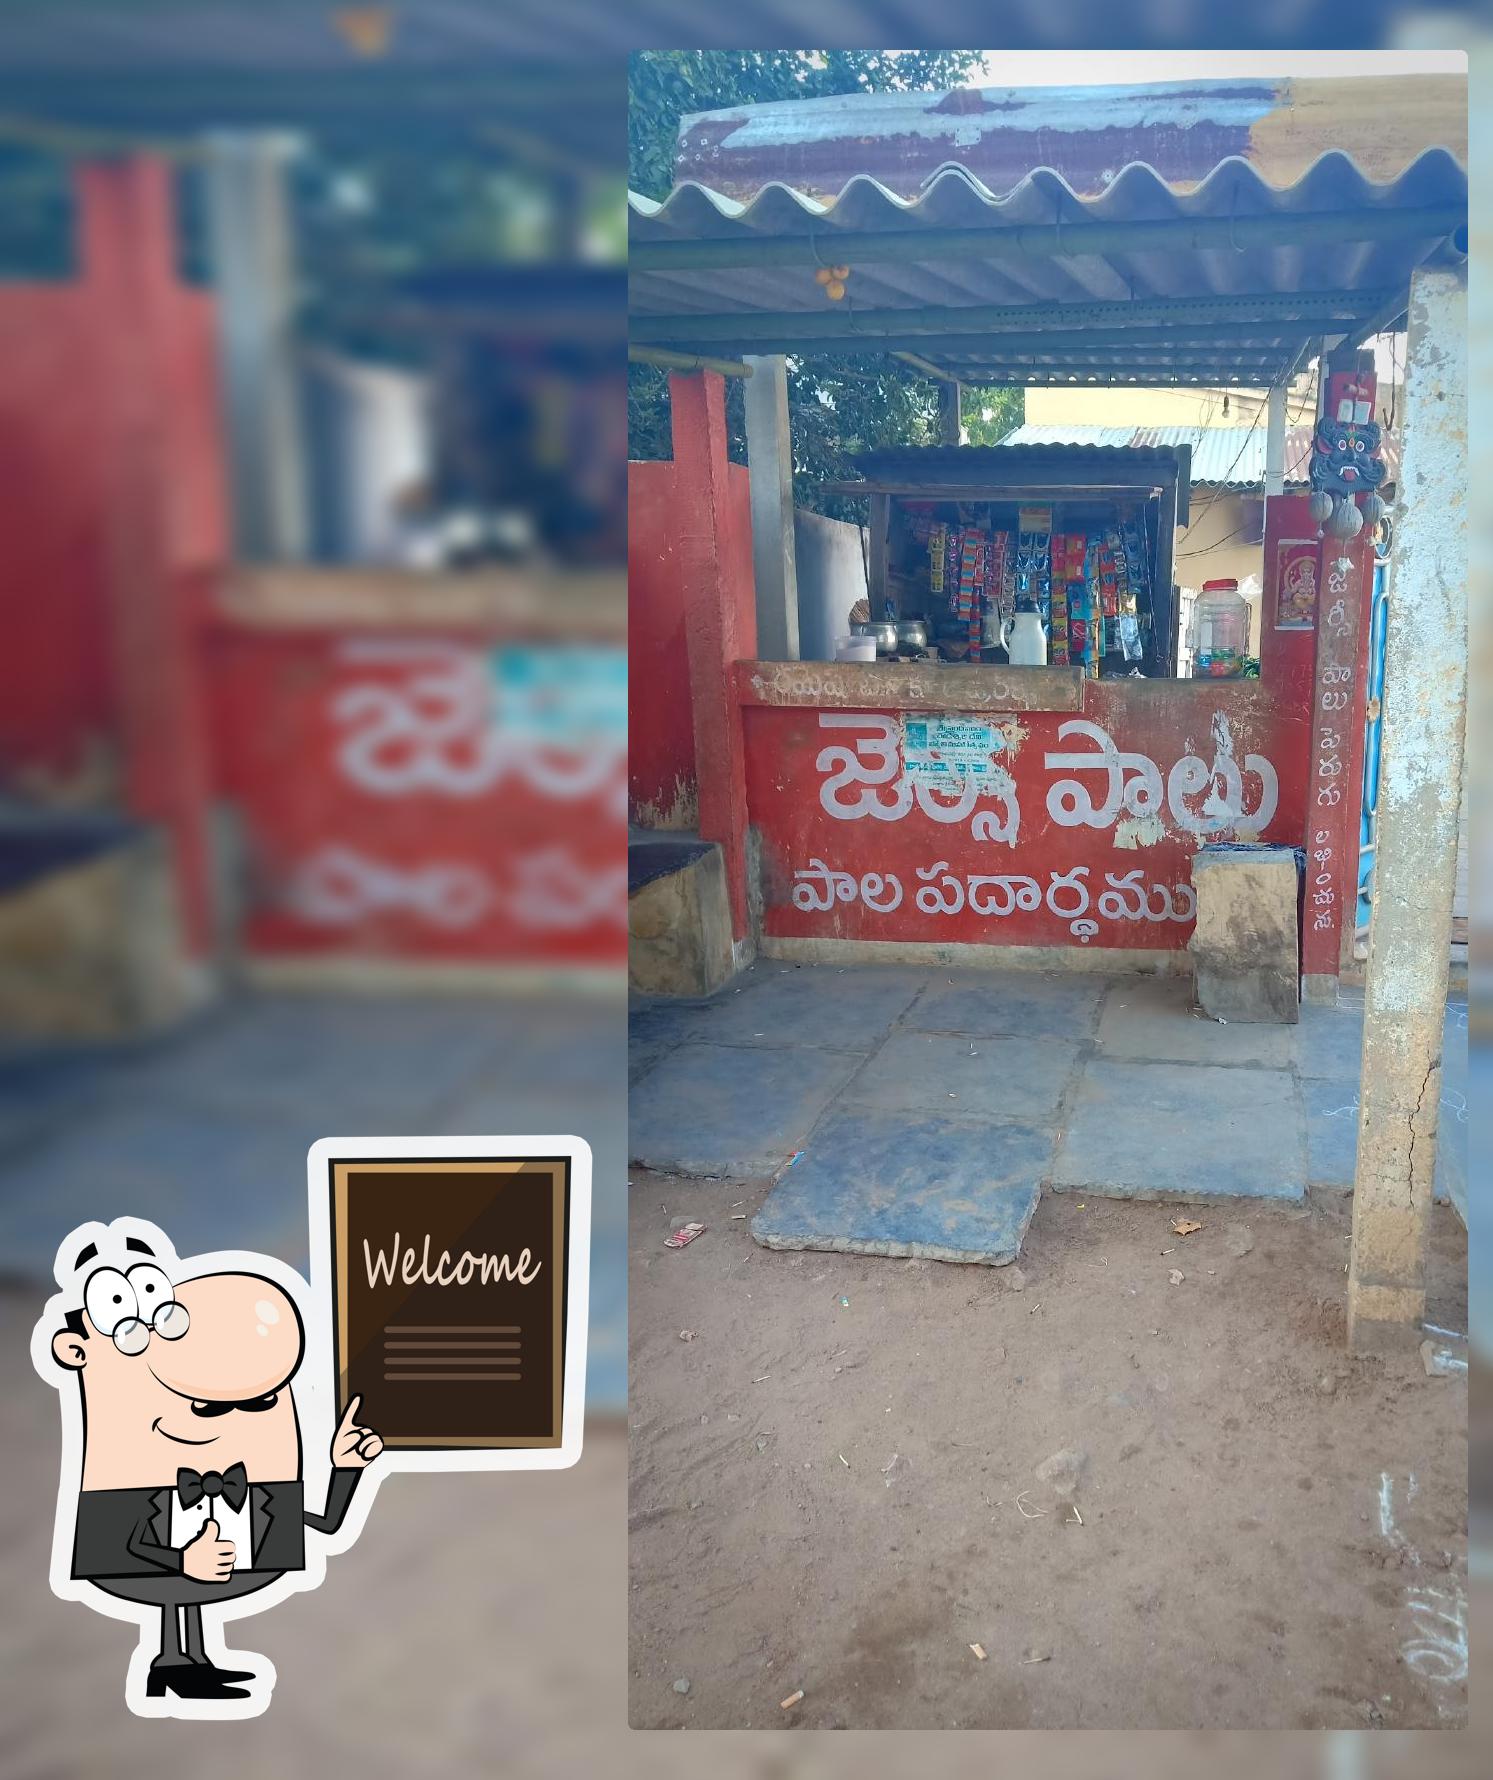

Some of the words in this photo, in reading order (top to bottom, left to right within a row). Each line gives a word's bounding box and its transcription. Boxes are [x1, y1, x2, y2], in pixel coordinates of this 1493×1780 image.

[1045, 718, 1279, 836] పాలు
[1317, 727, 1342, 807] పెరుగు
[791, 858, 903, 914] పాల
